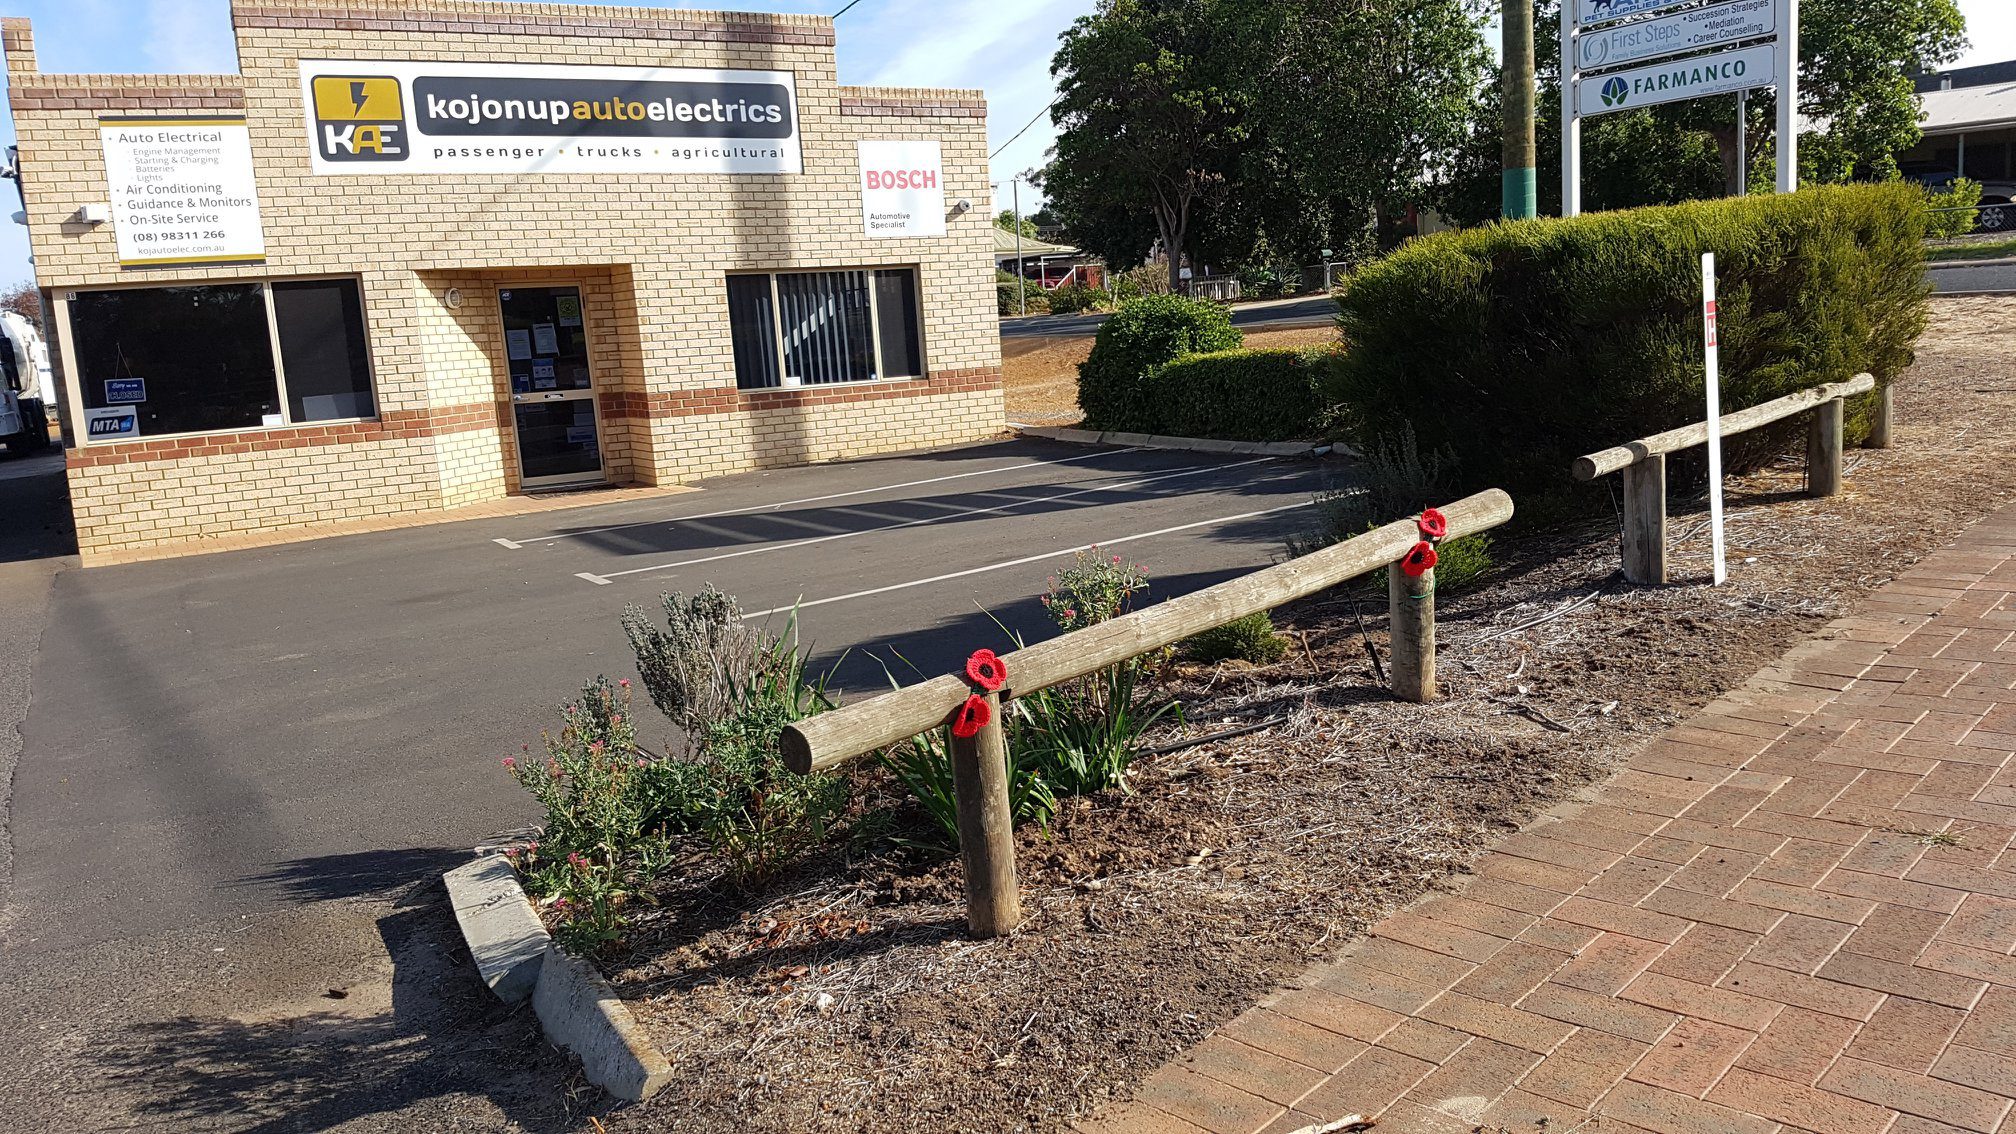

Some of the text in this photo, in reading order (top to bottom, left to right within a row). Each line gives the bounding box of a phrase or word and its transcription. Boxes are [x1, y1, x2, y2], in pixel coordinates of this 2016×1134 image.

[1608, 1, 1659, 16] SUPPLIES
[1688, 0, 1769, 22] Succession Strategies
[1709, 16, 1744, 30] Mediation
[1612, 24, 1680, 49] First Steps
[1693, 23, 1763, 44] Career Counselling
[1656, 42, 1681, 51] Solutions
[1634, 60, 1746, 94] FARMANCO
[1700, 78, 1766, 93] www.farmanco.com.au
[427, 93, 782, 125] kojonupautoelectrics
[119, 132, 222, 143] Auto Electrical
[324, 124, 401, 154] KAE
[133, 148, 220, 157] Engine Management
[434, 146, 784, 159] passenger trucks agricultural
[135, 157, 169, 165] Starting
[181, 156, 219, 165] Charging
[137, 174, 163, 182] Lights
[866, 170, 936, 189] BOSCH
[126, 183, 222, 195] Air Conditioning
[128, 197, 252, 209] Guidance & Monitors
[130, 213, 219, 225] On-Site Service
[133, 230, 225, 242] (08) 98311 266
[138, 245, 225, 256] kojautoelec.com.au
[93, 419, 119, 432] MTA
